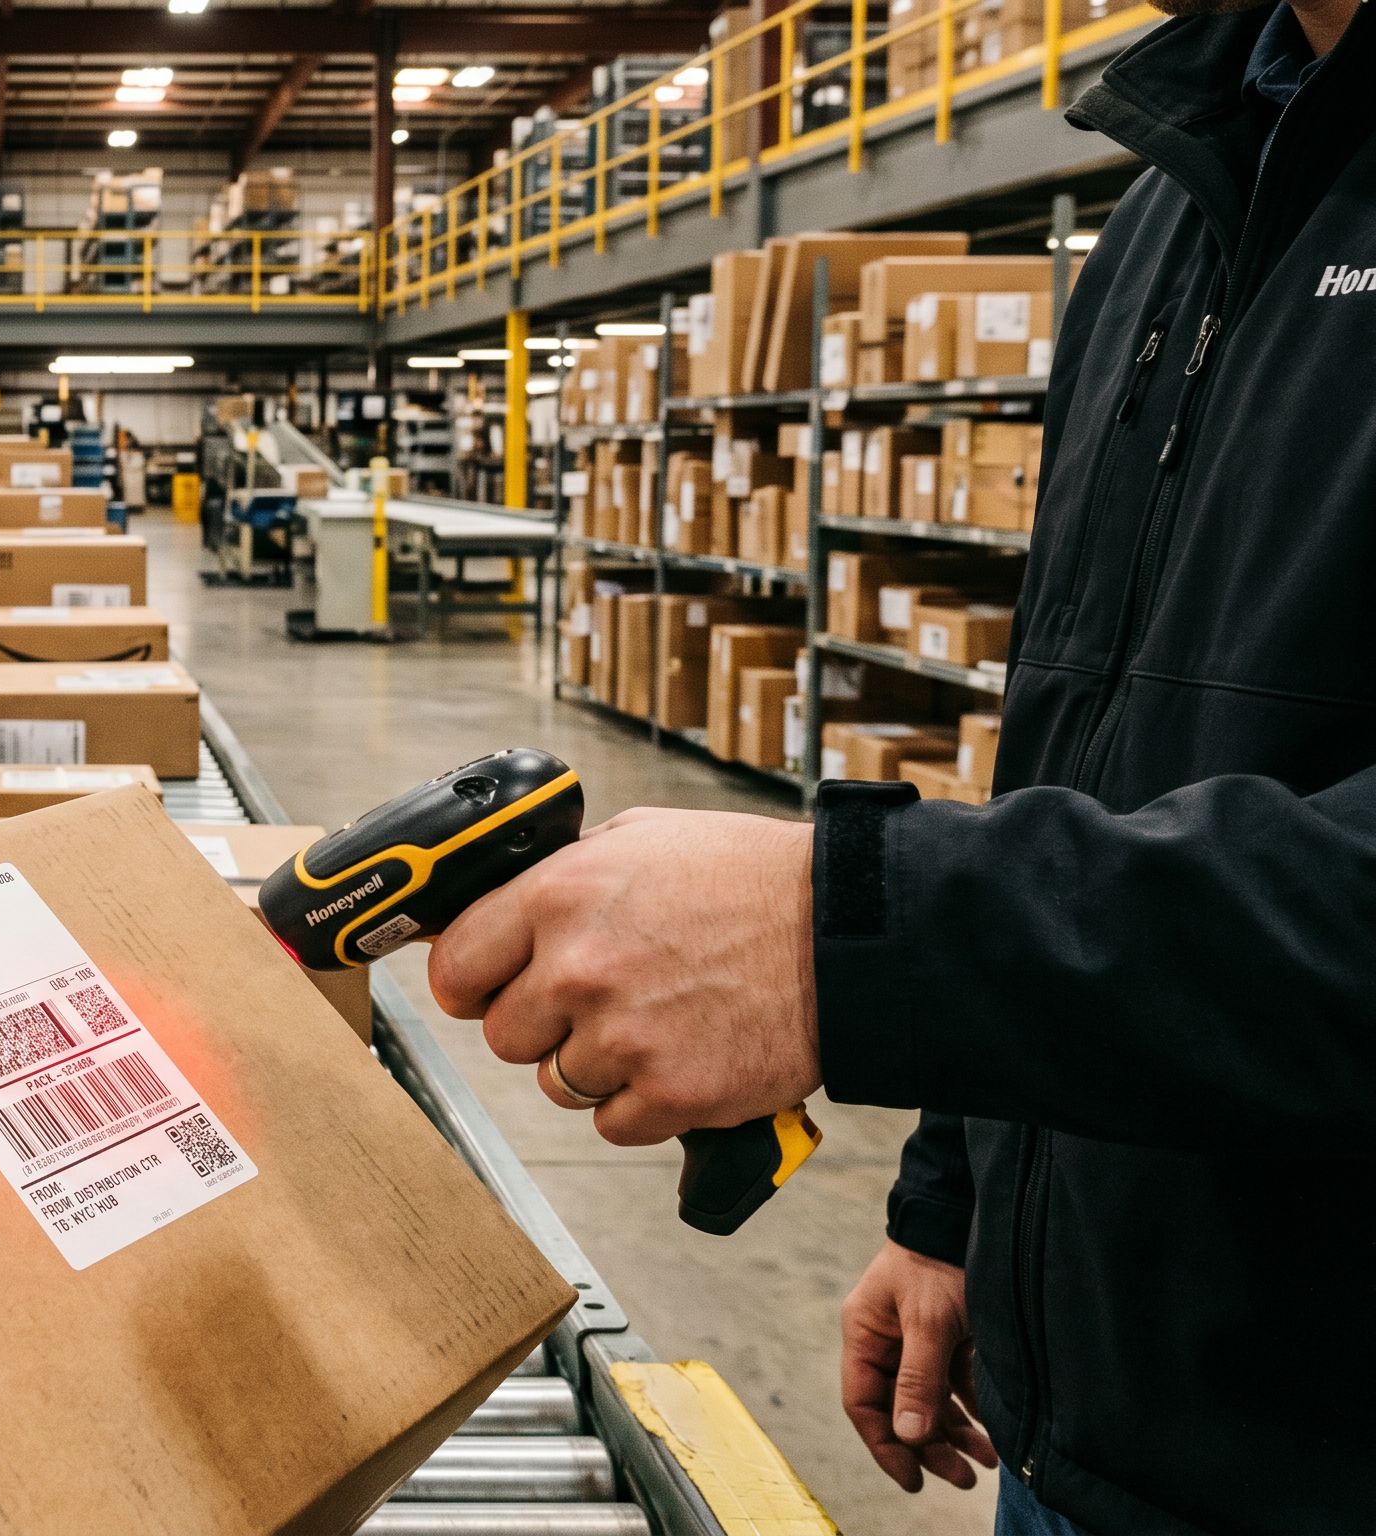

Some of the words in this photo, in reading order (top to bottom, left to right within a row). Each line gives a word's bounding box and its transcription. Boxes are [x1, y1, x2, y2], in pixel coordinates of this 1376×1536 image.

[305, 873, 384, 927] Honeywell
[139, 1154, 163, 1172] CTR
[29, 1181, 66, 1205] FROM:
[94, 1194, 120, 1214] HUB
